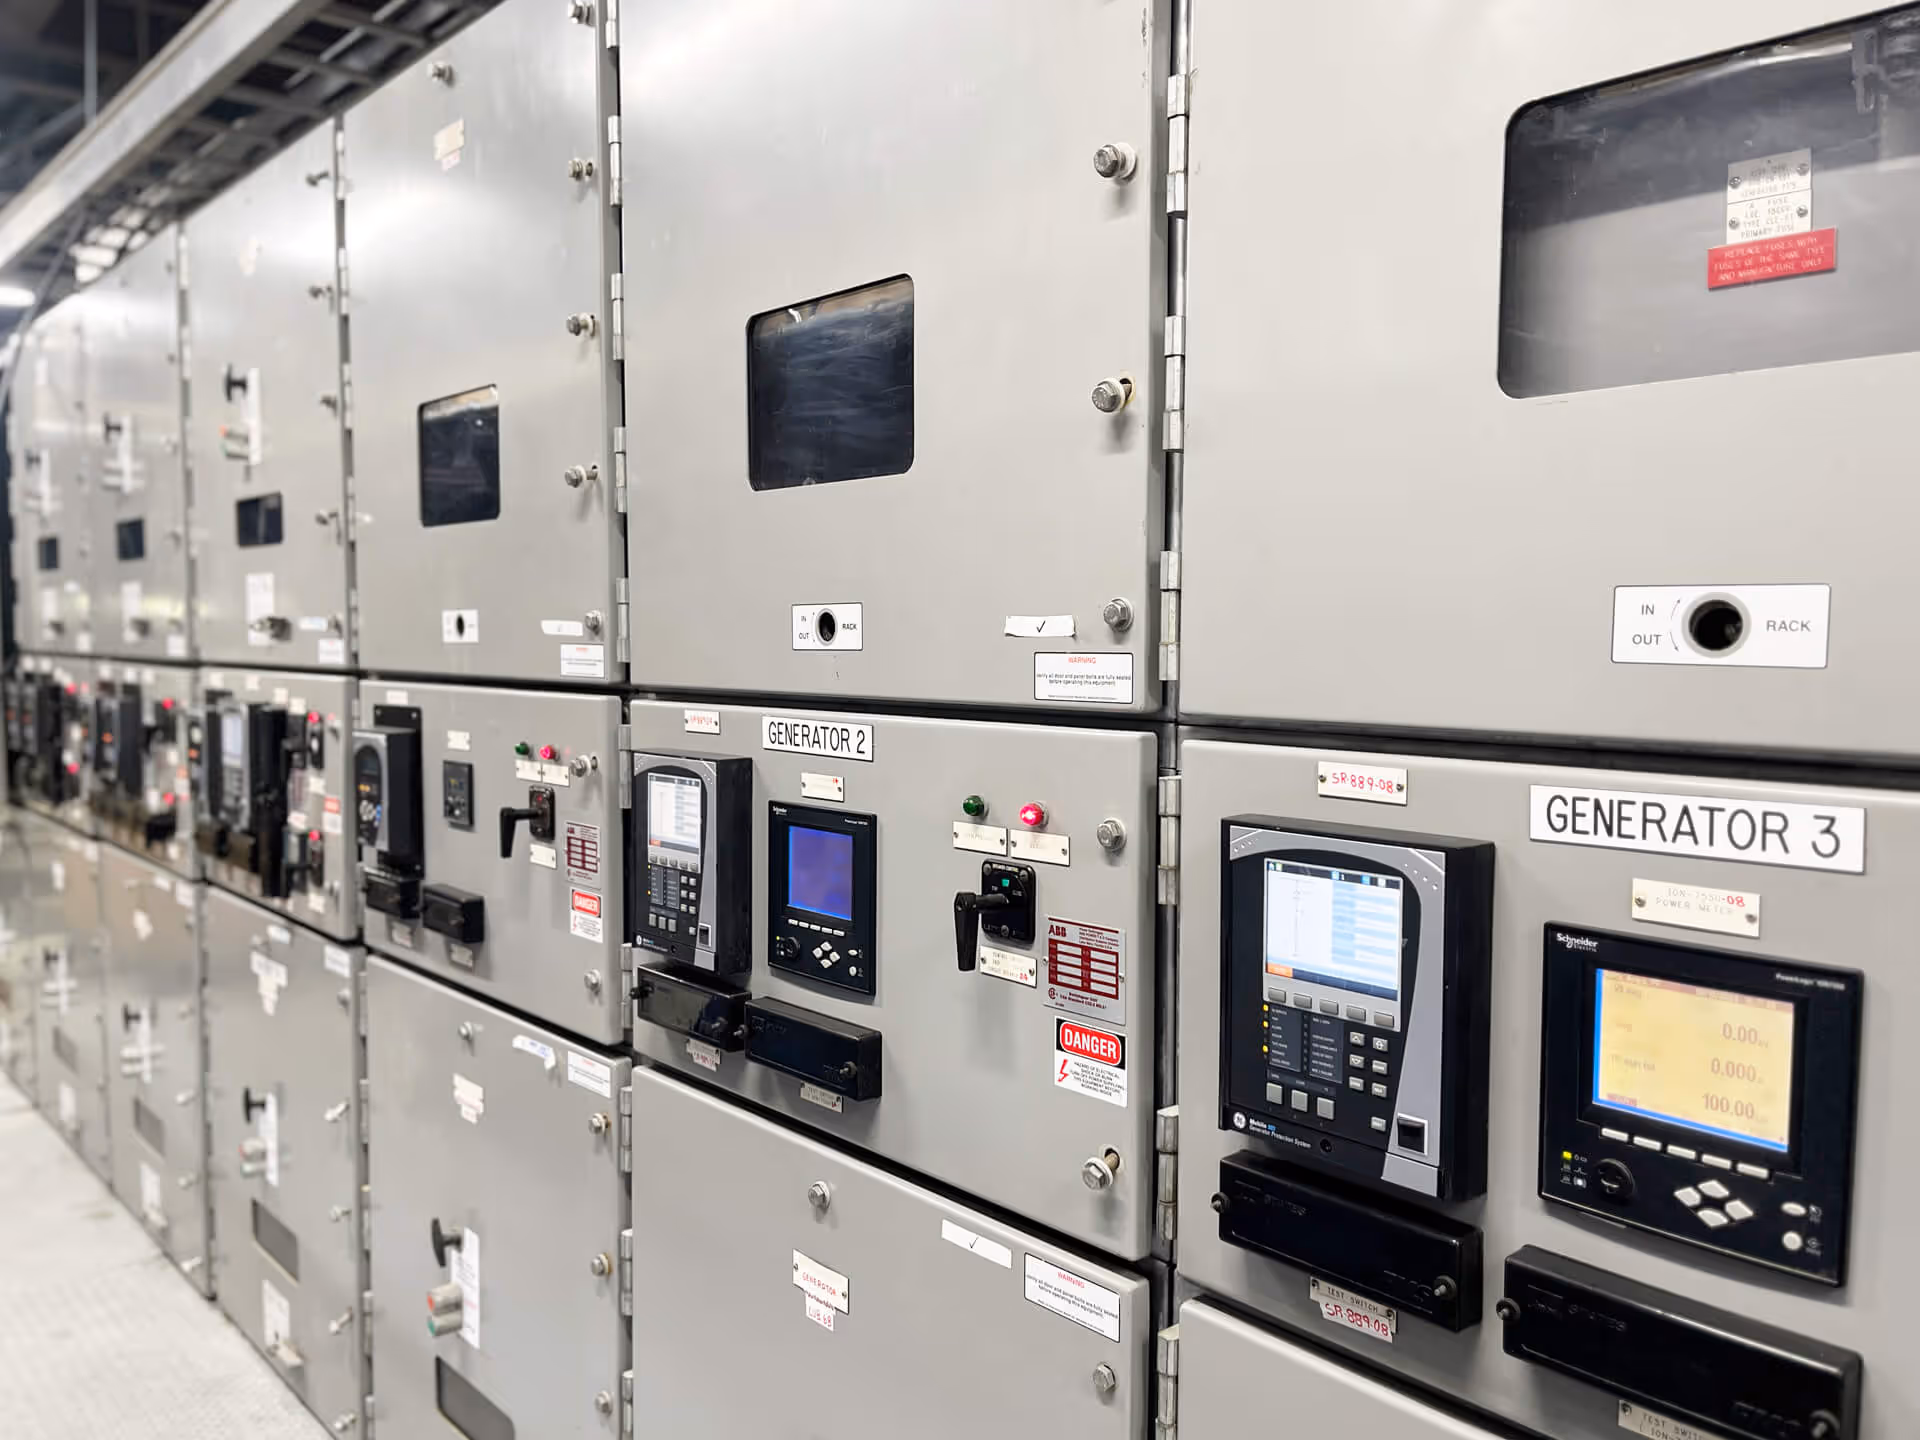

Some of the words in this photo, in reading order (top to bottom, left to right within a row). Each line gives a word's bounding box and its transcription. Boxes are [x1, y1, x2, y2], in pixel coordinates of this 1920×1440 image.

[1641, 604, 1655, 616] IN
[800, 615, 807, 623] IN
[842, 623, 857, 631] RACK
[1765, 619, 1812, 632] RACK
[798, 632, 809, 640] OUT
[1632, 633, 1662, 645] OUT
[1067, 656, 1097, 664] WARNING
[768, 720, 851, 753] GENERATOR
[856, 729, 866, 754] 2
[1546, 793, 1790, 855] GENERATOR
[1811, 815, 1841, 859] 3
[1655, 896, 1691, 910] POWER
[1047, 924, 1067, 938] ABB
[1556, 932, 1599, 948] Schneider
[1721, 1021, 1759, 1046] 0.00
[1064, 1028, 1117, 1060] DANGER
[1710, 1056, 1757, 1084] 0.000
[1701, 1091, 1755, 1121] 100.00
[1249, 1124, 1271, 1136] Generator
[1271, 1131, 1294, 1143] Protection
[1294, 1138, 1312, 1149] System
[1057, 1271, 1086, 1289] WARNING
[1327, 1286, 1345, 1300] TEST
[1349, 1296, 1378, 1313] SWITCH
[1642, 1411, 1667, 1429] TEST
